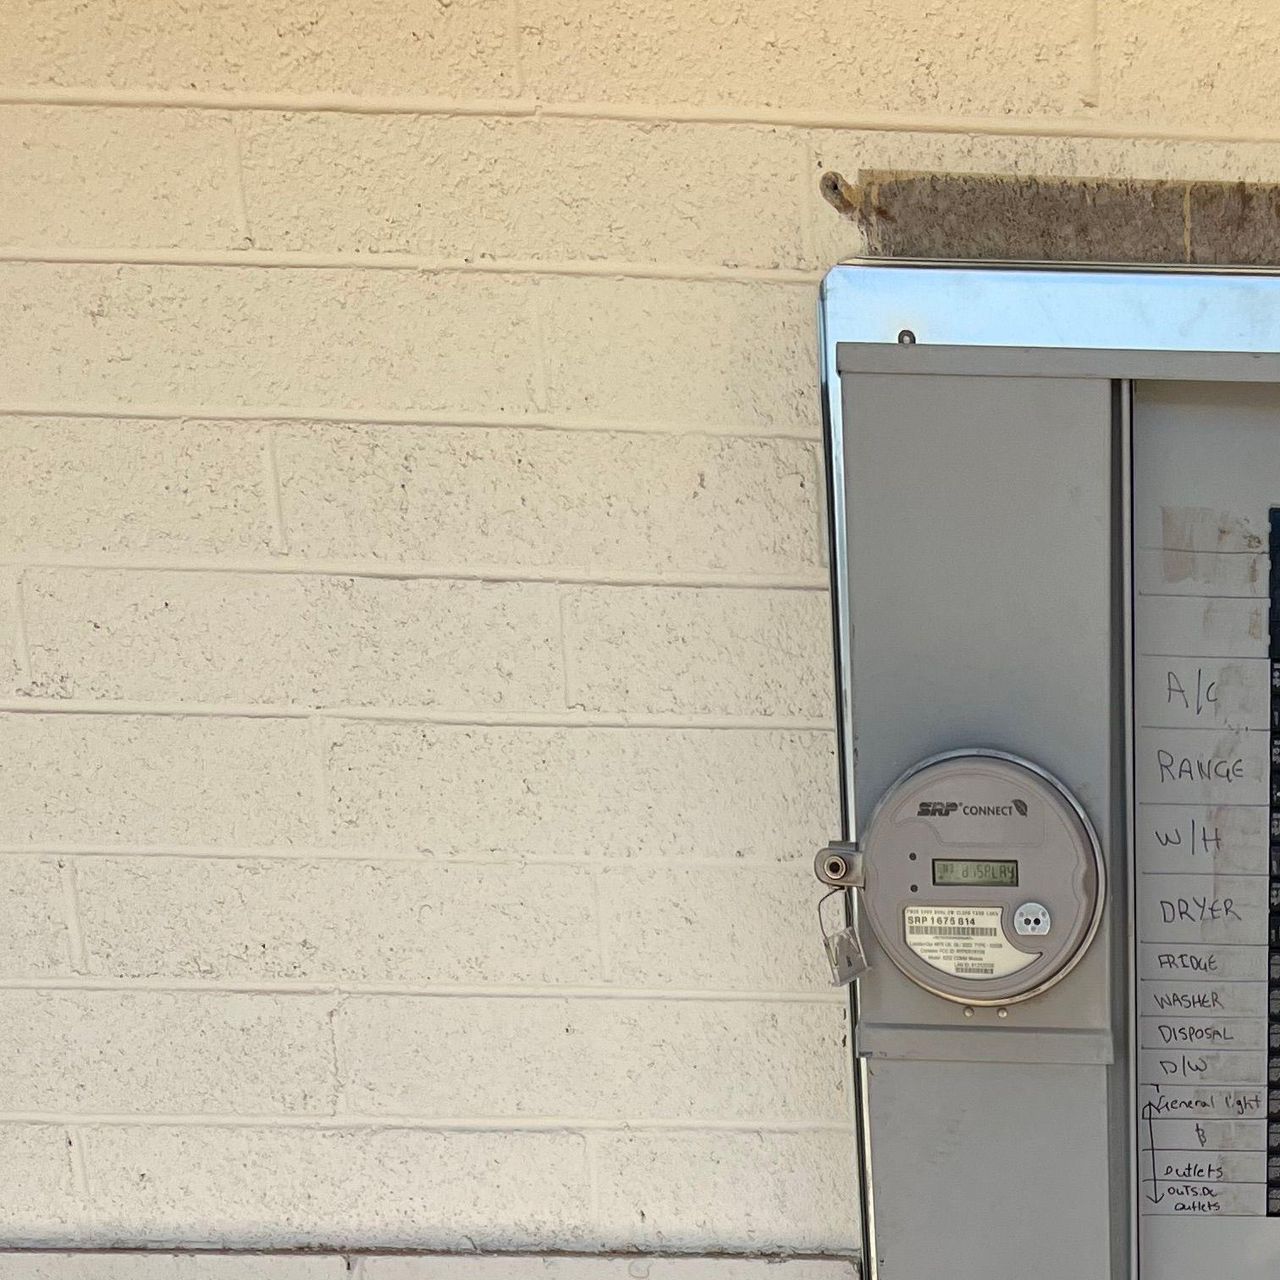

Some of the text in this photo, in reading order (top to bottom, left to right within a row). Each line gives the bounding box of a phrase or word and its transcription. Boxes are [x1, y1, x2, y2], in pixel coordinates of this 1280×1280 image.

[1167, 669, 1219, 714] A/C
[1157, 750, 1245, 783] RANGE
[917, 802, 1013, 817] SRP CONNECT
[1155, 818, 1222, 856] W/H
[908, 916, 928, 925] SRP
[1160, 898, 1242, 923] DRYER
[1158, 953, 1219, 972] FRIDGE
[1153, 992, 1224, 1010] WASHER
[1158, 1024, 1234, 1042] DISPOSAL
[1160, 1055, 1207, 1076] D/W
